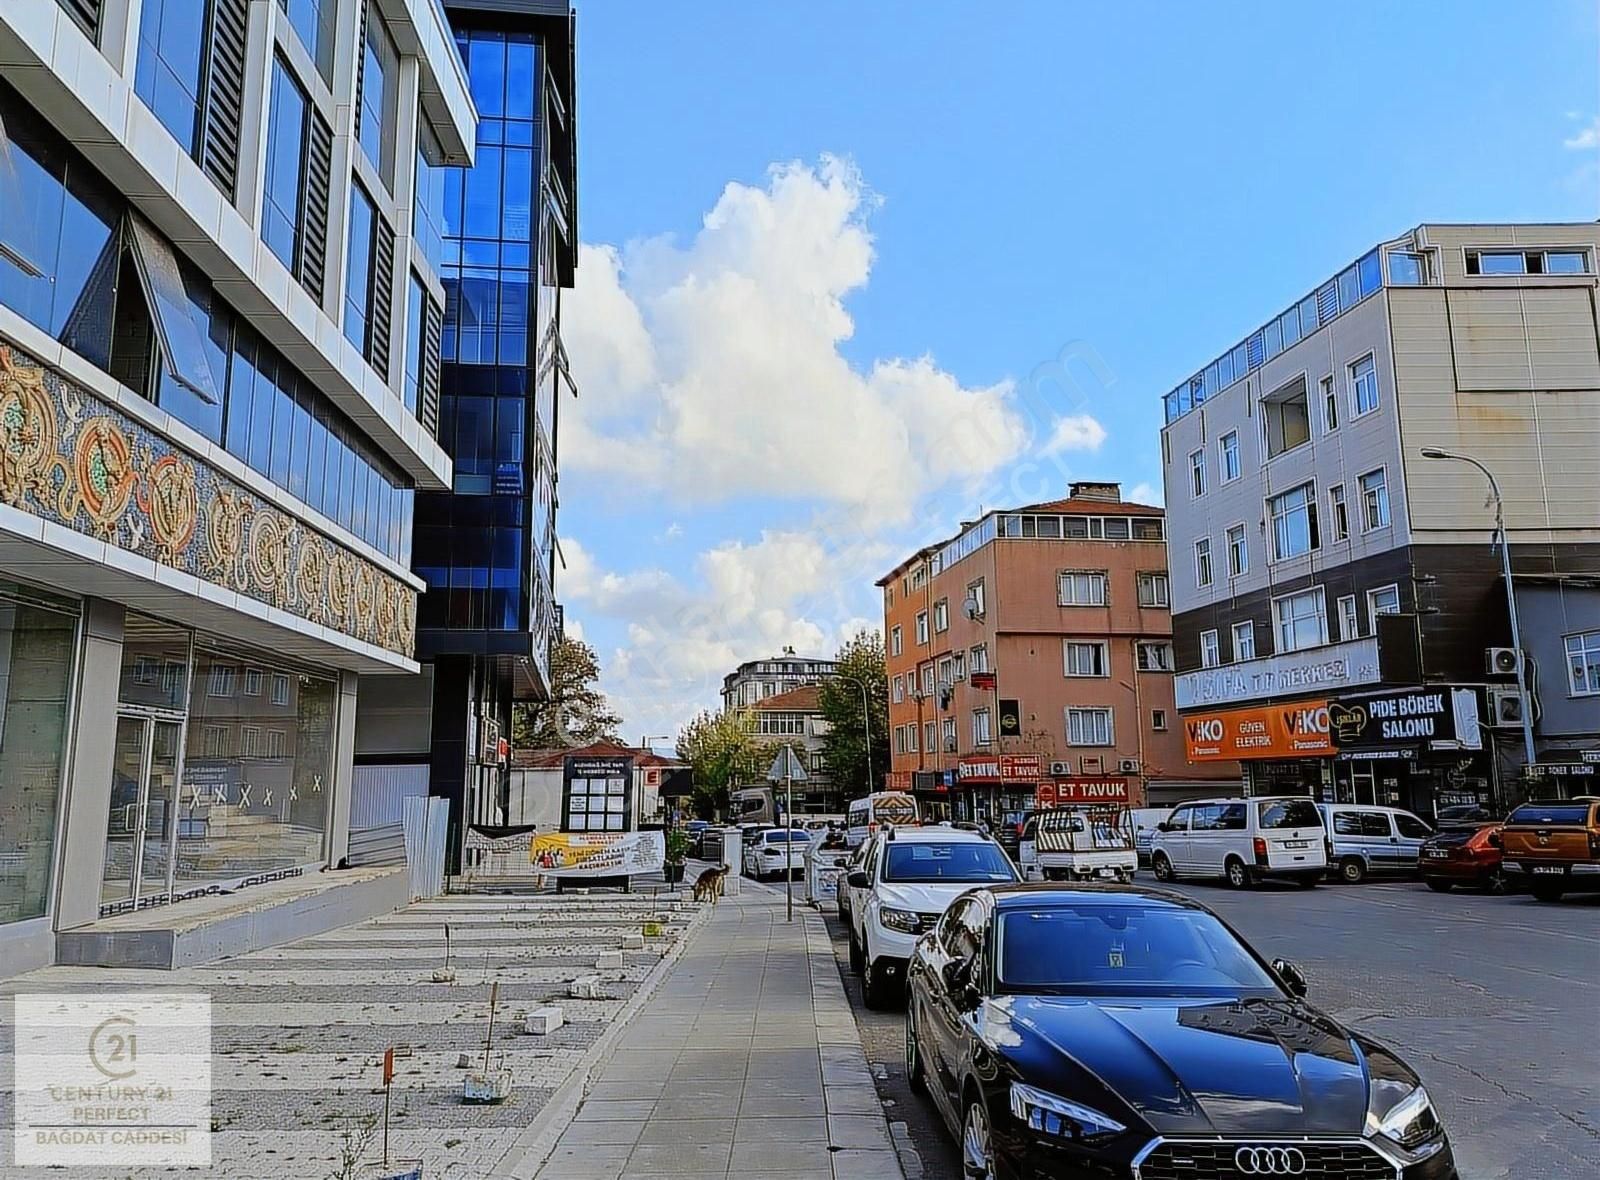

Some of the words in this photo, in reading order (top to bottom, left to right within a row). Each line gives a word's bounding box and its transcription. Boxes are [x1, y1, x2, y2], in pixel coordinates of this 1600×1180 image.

[1398, 694, 1445, 717] BÖREK
[1239, 720, 1265, 734] GÜVEN
[1382, 717, 1434, 738] SALONU
[1003, 767, 1012, 776] ET
[1015, 766, 1039, 777] TAVUK
[1059, 783, 1076, 797] ET
[1080, 783, 1126, 797] TAVUK
